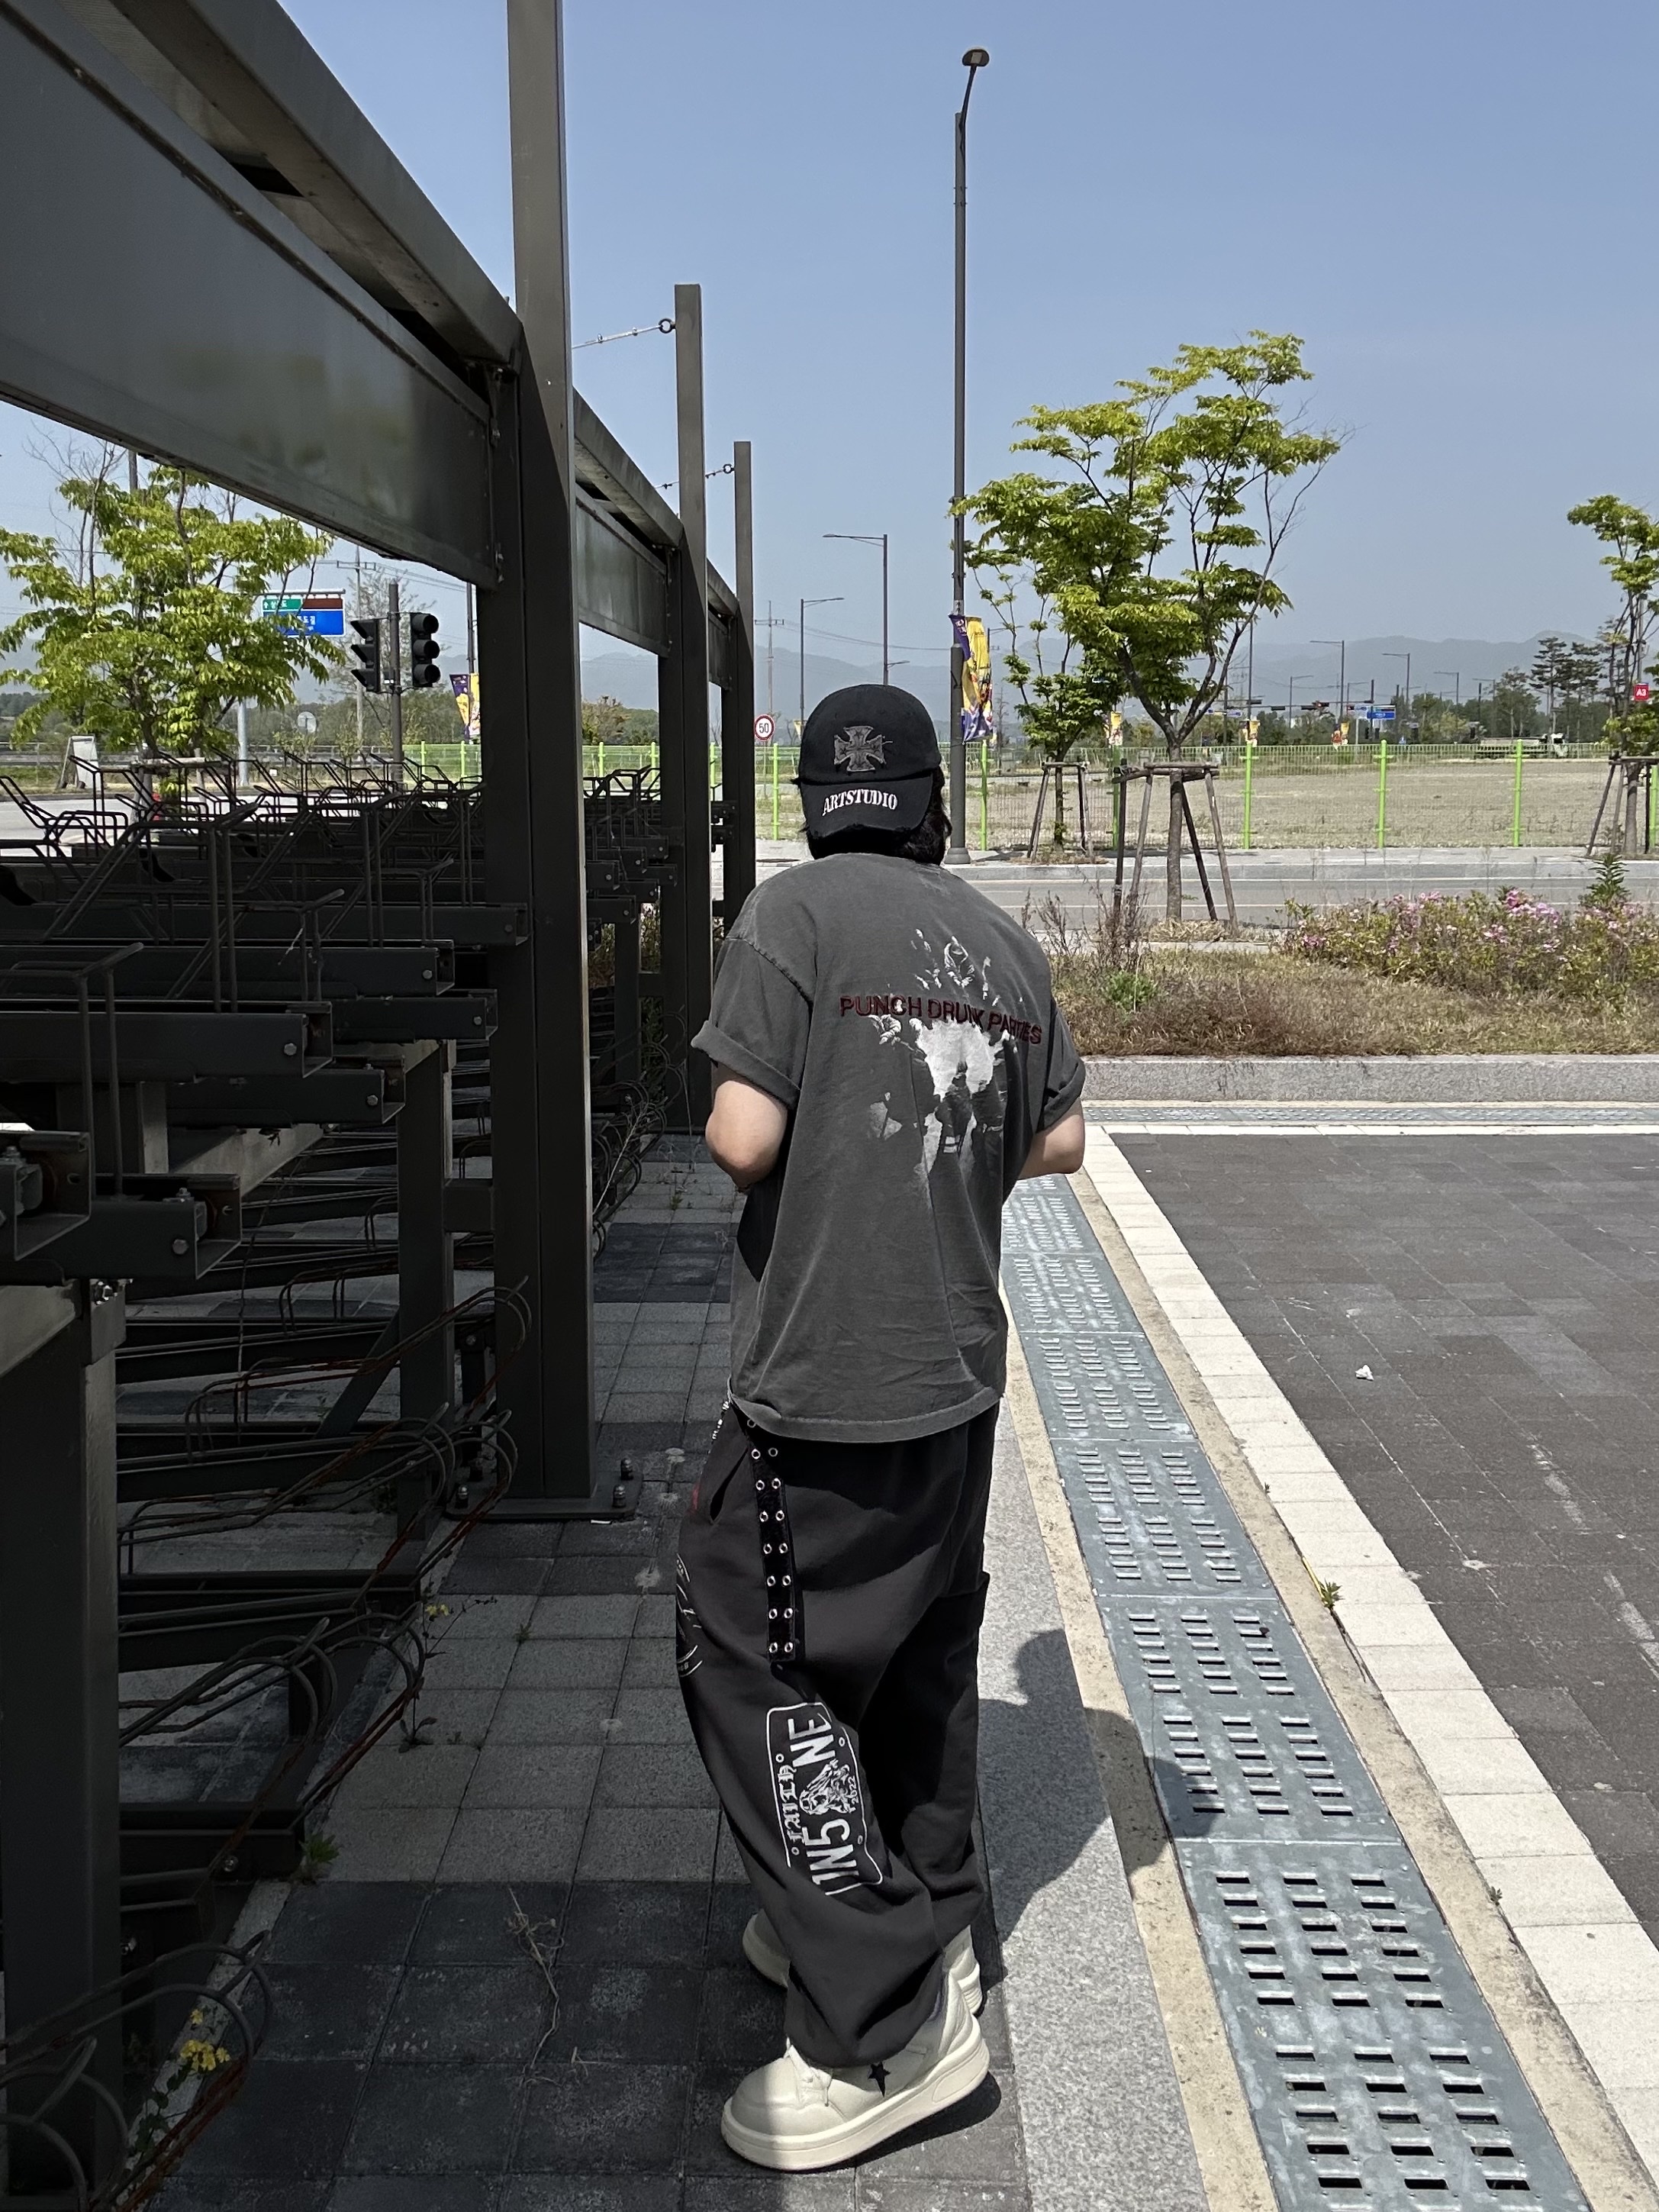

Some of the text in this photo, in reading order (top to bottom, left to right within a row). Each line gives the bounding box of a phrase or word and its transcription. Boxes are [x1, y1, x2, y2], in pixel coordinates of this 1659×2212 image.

[759, 723, 769, 734] 50
[822, 788, 898, 817] ARTSTUDIO
[839, 995, 1042, 1044] PUNCH DRUNK PARTIES
